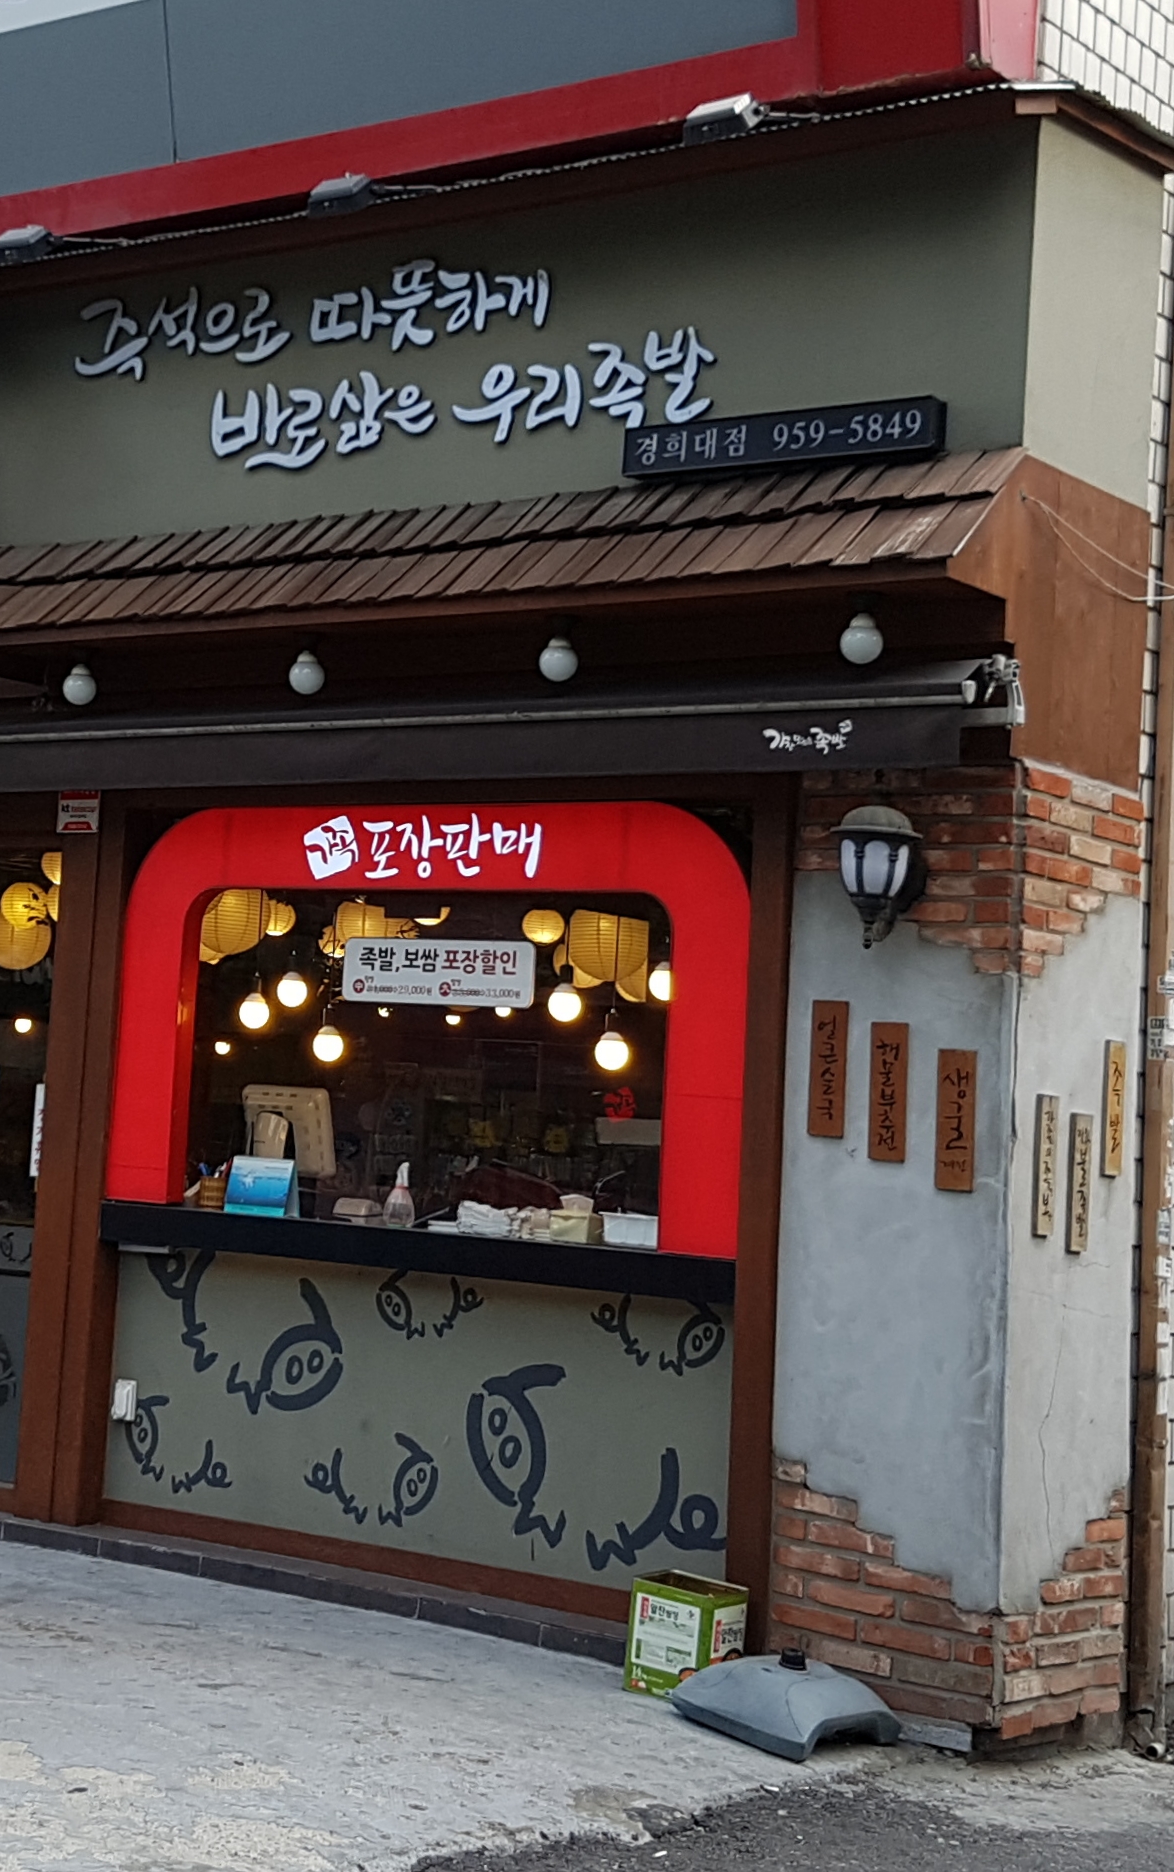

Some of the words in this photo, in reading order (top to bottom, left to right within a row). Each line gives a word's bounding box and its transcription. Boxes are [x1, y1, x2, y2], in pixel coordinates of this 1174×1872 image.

[74, 286, 293, 382] 즉석으로
[310, 260, 551, 351] 따뜻하게
[451, 326, 715, 444] 우리족발
[635, 425, 748, 466] 경희대점
[772, 409, 922, 452] 959-5849
[362, 812, 542, 879] 포장판매
[440, 948, 518, 976] 포장할인
[816, 1015, 839, 1121] 얼큰술국
[876, 1039, 900, 1151] 해물부추전
[942, 1067, 970, 1151] 생굴
[1109, 1060, 1124, 1155] 족발
